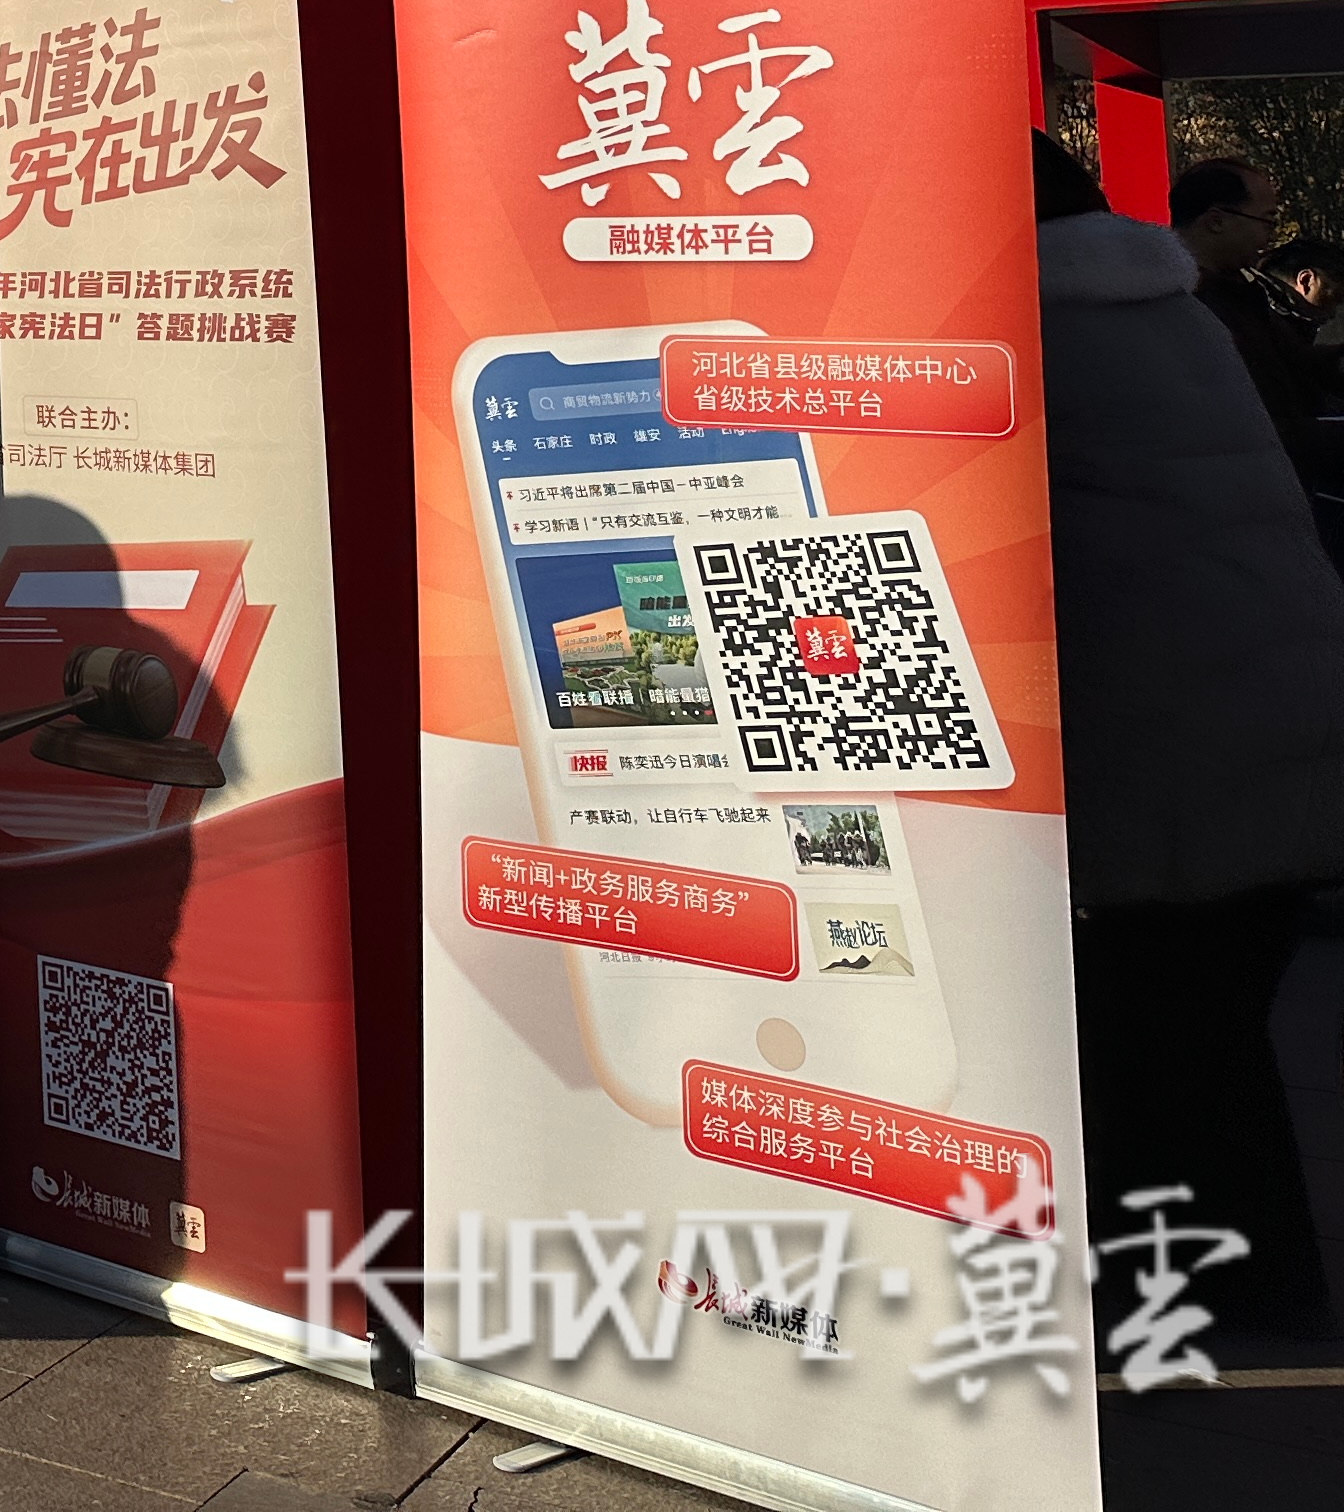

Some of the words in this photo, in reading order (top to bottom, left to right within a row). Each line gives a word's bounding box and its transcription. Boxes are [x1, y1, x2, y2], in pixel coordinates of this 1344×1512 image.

[608, 221, 775, 256] 融媒体平台
[692, 351, 977, 386] 河北省县级融媒体中心
[35, 404, 131, 432] 联合主办：
[693, 386, 883, 418] 省级技术总平台
[491, 439, 517, 454] 头条
[532, 434, 573, 451] 石家庄
[589, 431, 618, 446] 时政
[634, 428, 661, 443] 雄安
[677, 426, 705, 440] 活动
[72, 446, 217, 479] 长城新媒体集团
[572, 754, 608, 772] 快报
[569, 808, 771, 825] 产赛联动，让自行车飞驰起来
[491, 854, 750, 918] “新闻+政务服务商务”
[477, 884, 638, 934] 新型传播平台
[826, 919, 888, 948] 燕赵论坛
[701, 1077, 1029, 1179] 媒体深度参与社会治理的
[701, 1113, 875, 1180] 综合服务平台
[723, 1316, 754, 1332] Great
[756, 1325, 779, 1340] Wall
